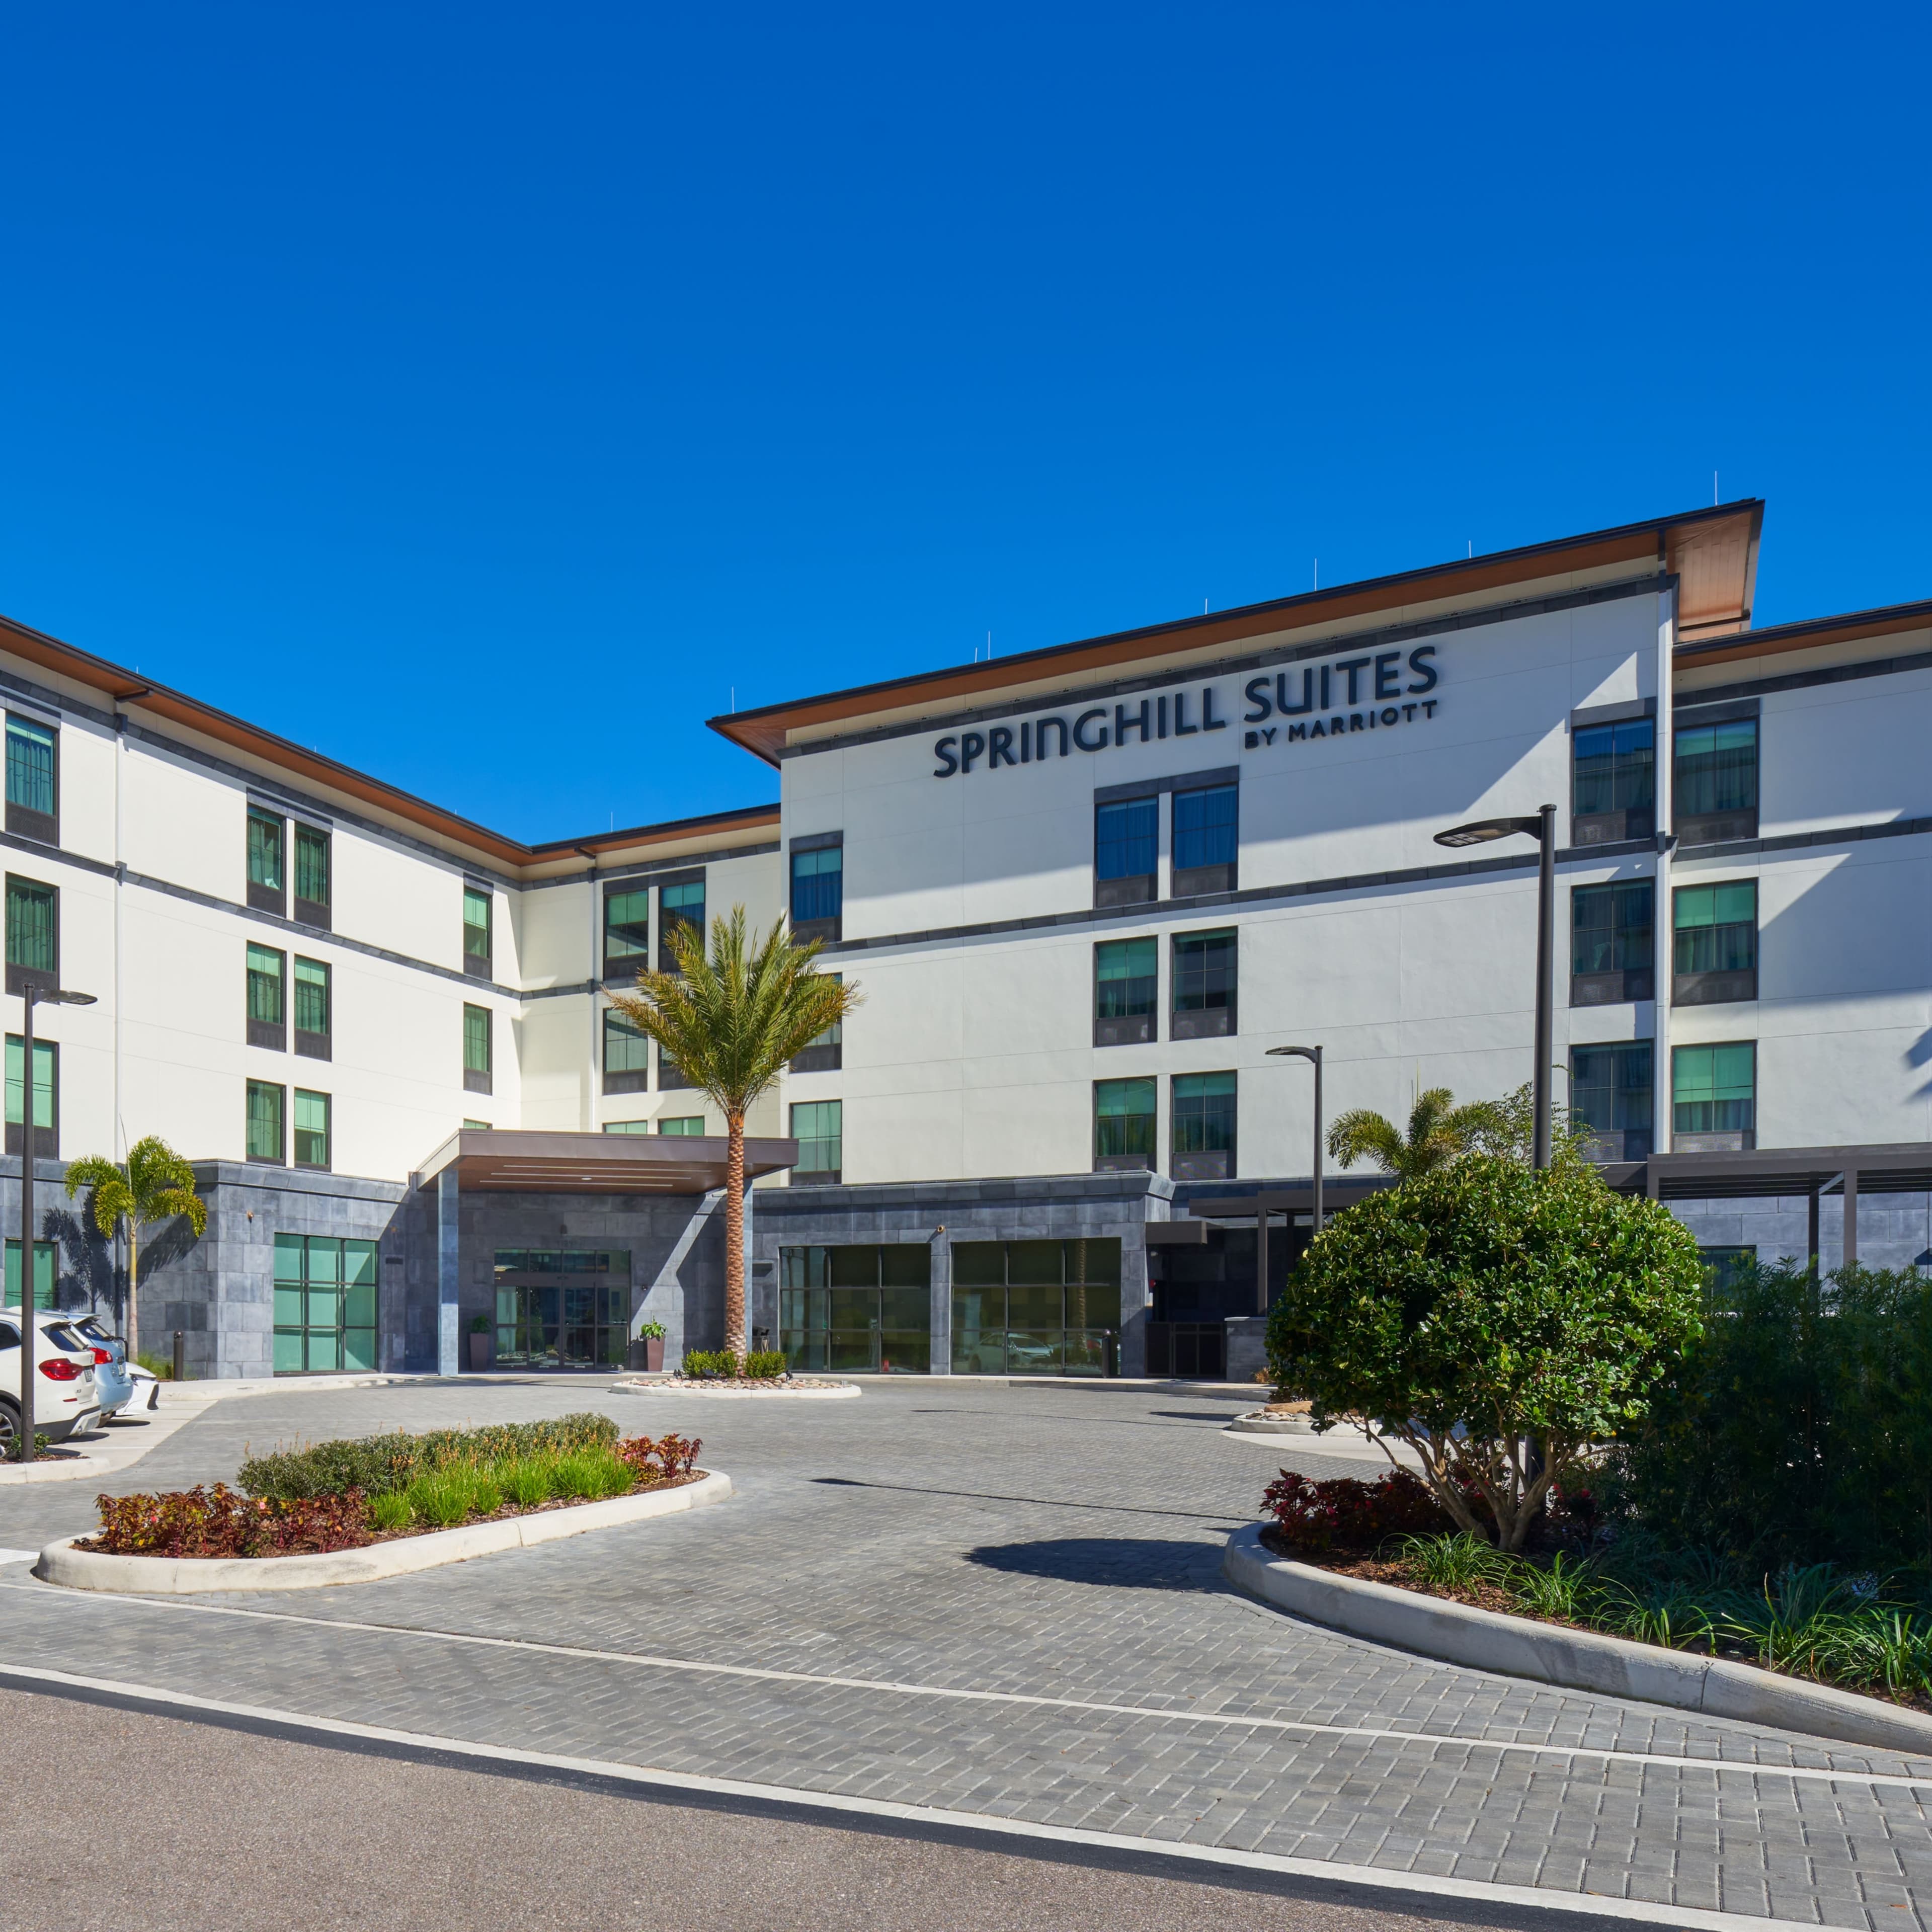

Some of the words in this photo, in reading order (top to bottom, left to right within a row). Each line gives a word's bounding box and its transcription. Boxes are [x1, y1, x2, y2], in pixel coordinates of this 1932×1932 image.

[1244, 646, 1437, 723] SUITES
[1245, 727, 1277, 749] BY
[1288, 699, 1437, 742] MARRIOTT
